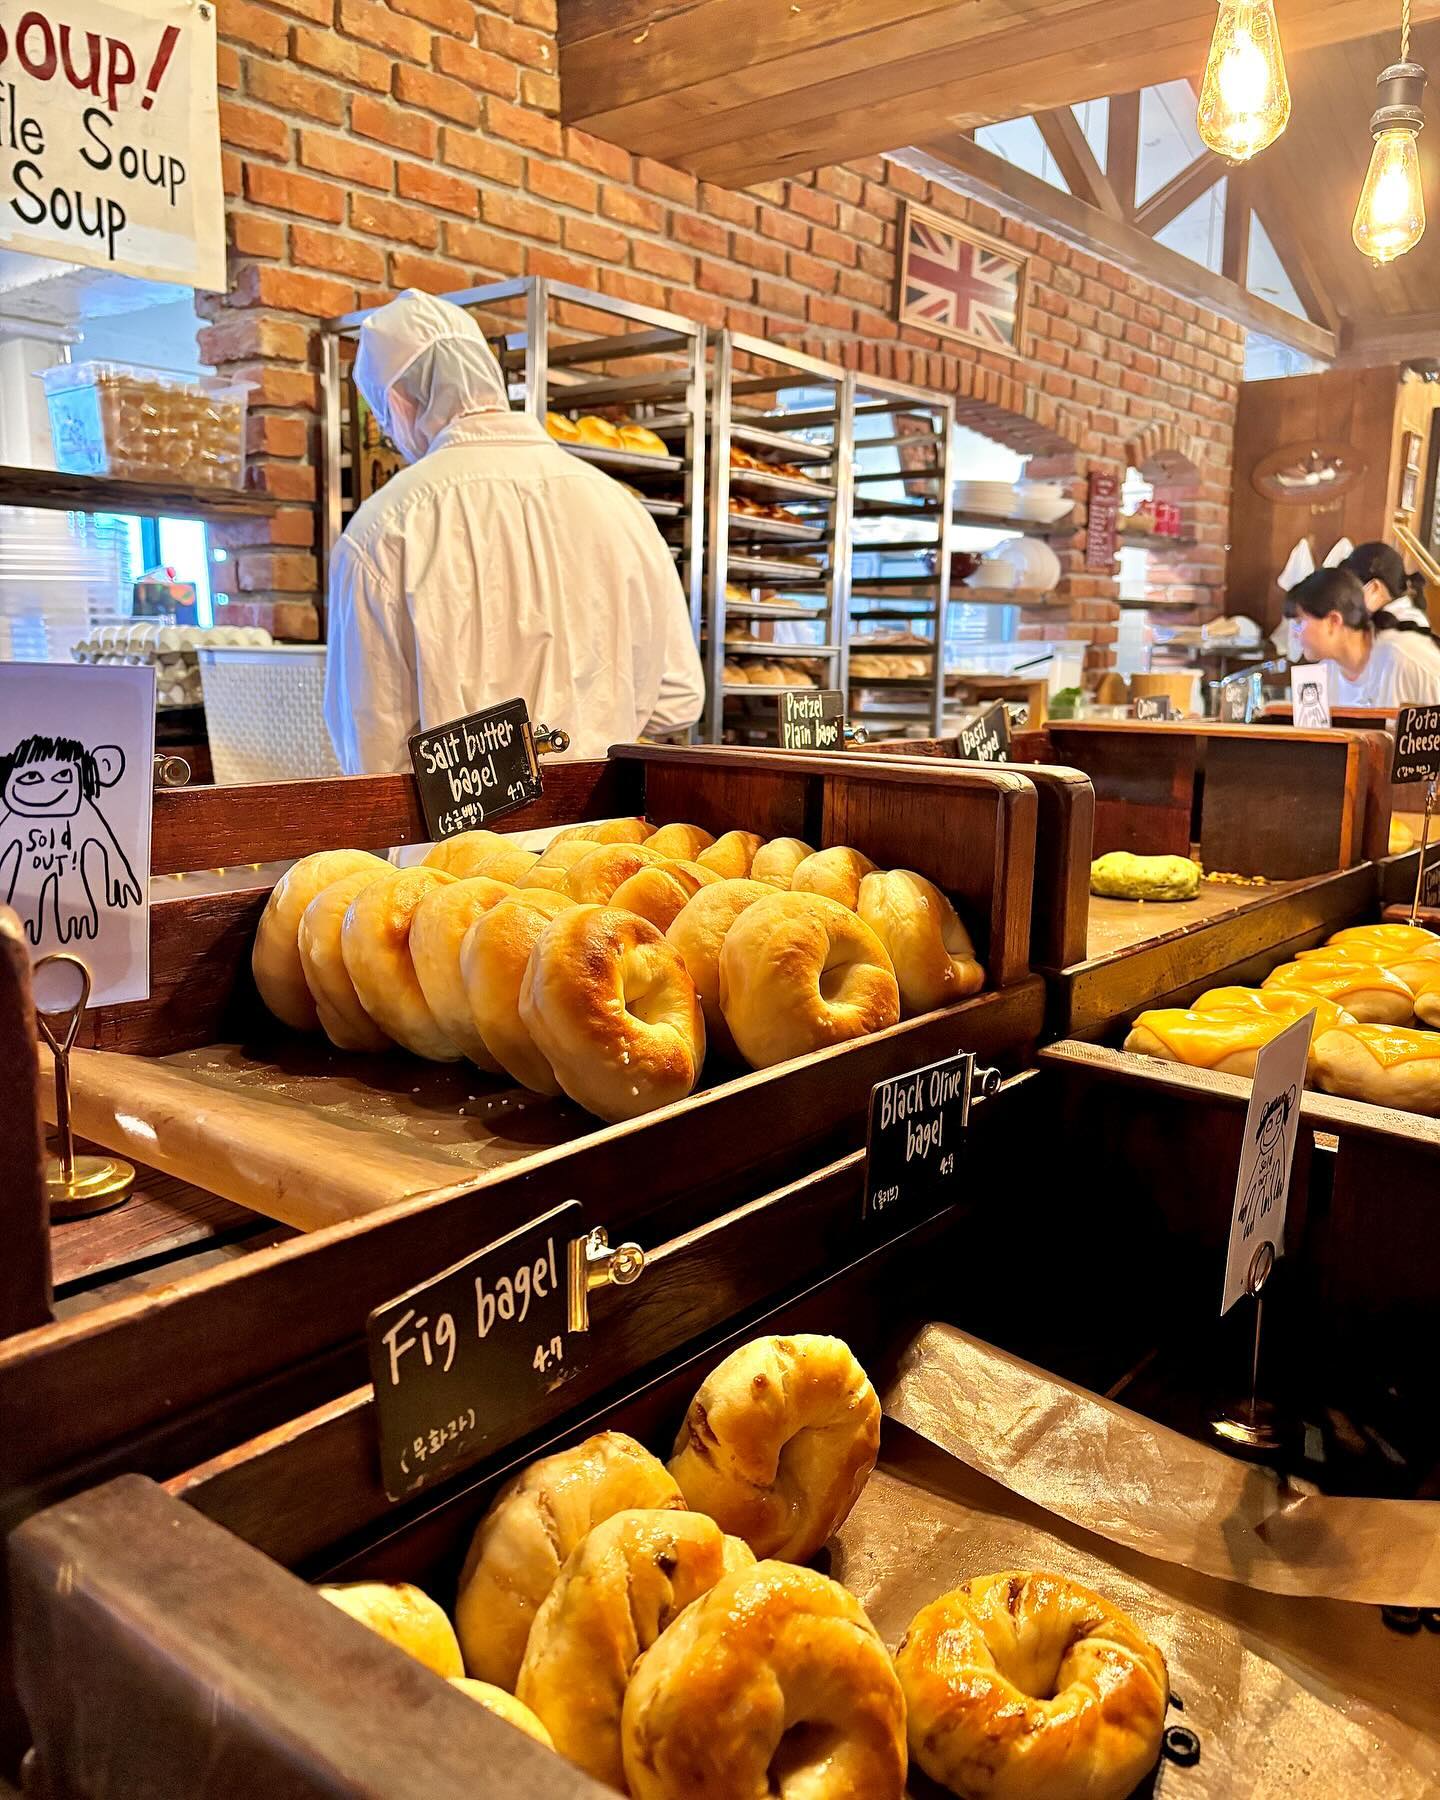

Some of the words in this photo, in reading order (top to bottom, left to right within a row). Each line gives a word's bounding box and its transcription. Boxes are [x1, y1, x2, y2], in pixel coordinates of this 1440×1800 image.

[79, 107, 186, 206] Soup
[9, 159, 126, 261] Soup
[787, 692, 823, 721] Pretzel
[1405, 708, 1440, 732] Pota
[420, 735, 460, 774] Salt
[463, 720, 513, 762] butter
[784, 722, 812, 749] Plain
[961, 716, 987, 757] Basil
[448, 754, 499, 803] bagel
[438, 801, 485, 835] (소금빵)
[32, 850, 77, 877] OUT!
[880, 1074, 924, 1130] Black
[929, 1070, 961, 1108] Olive
[906, 1111, 943, 1162] bagel
[872, 1184, 899, 1210] (올리브)
[382, 1309, 456, 1386] Fig
[475, 1236, 558, 1339] bagel
